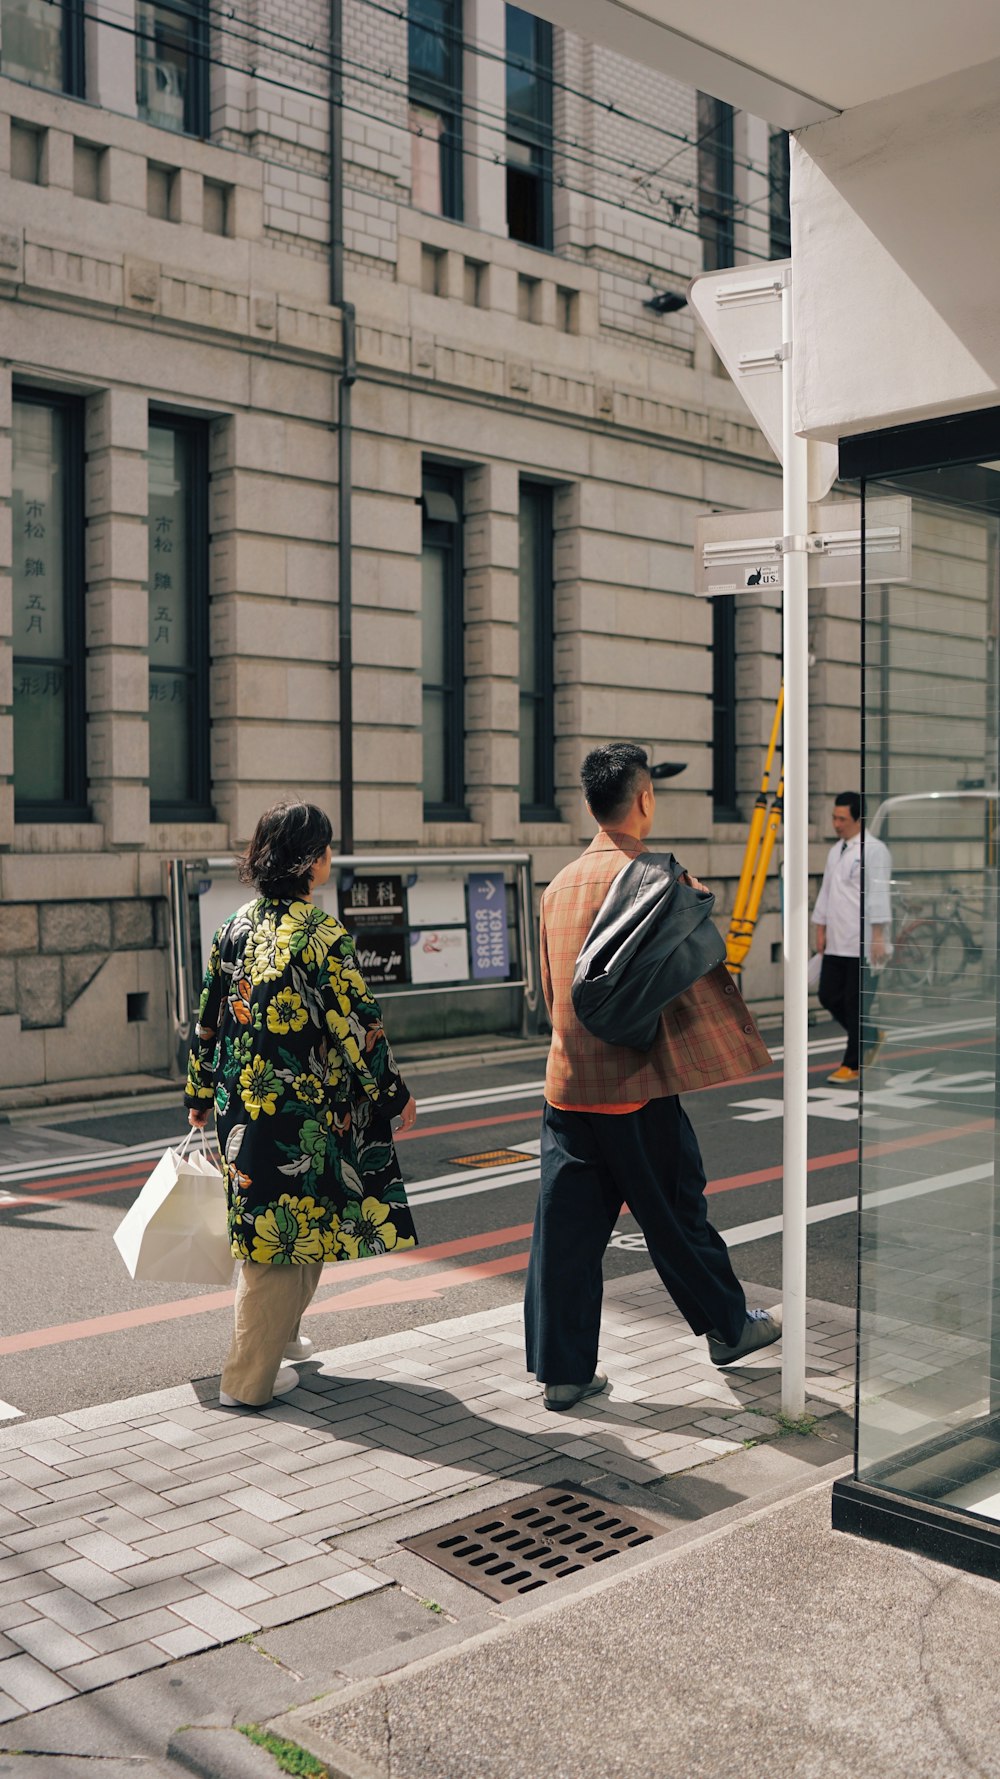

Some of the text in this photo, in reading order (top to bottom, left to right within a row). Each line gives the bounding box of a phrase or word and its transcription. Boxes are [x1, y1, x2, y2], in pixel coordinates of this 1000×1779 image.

[24, 499, 46, 539] 市松
[154, 515, 174, 552] 市松
[24, 593, 46, 634] 五月
[154, 606, 173, 643] 五月
[351, 882, 396, 906] 歯科
